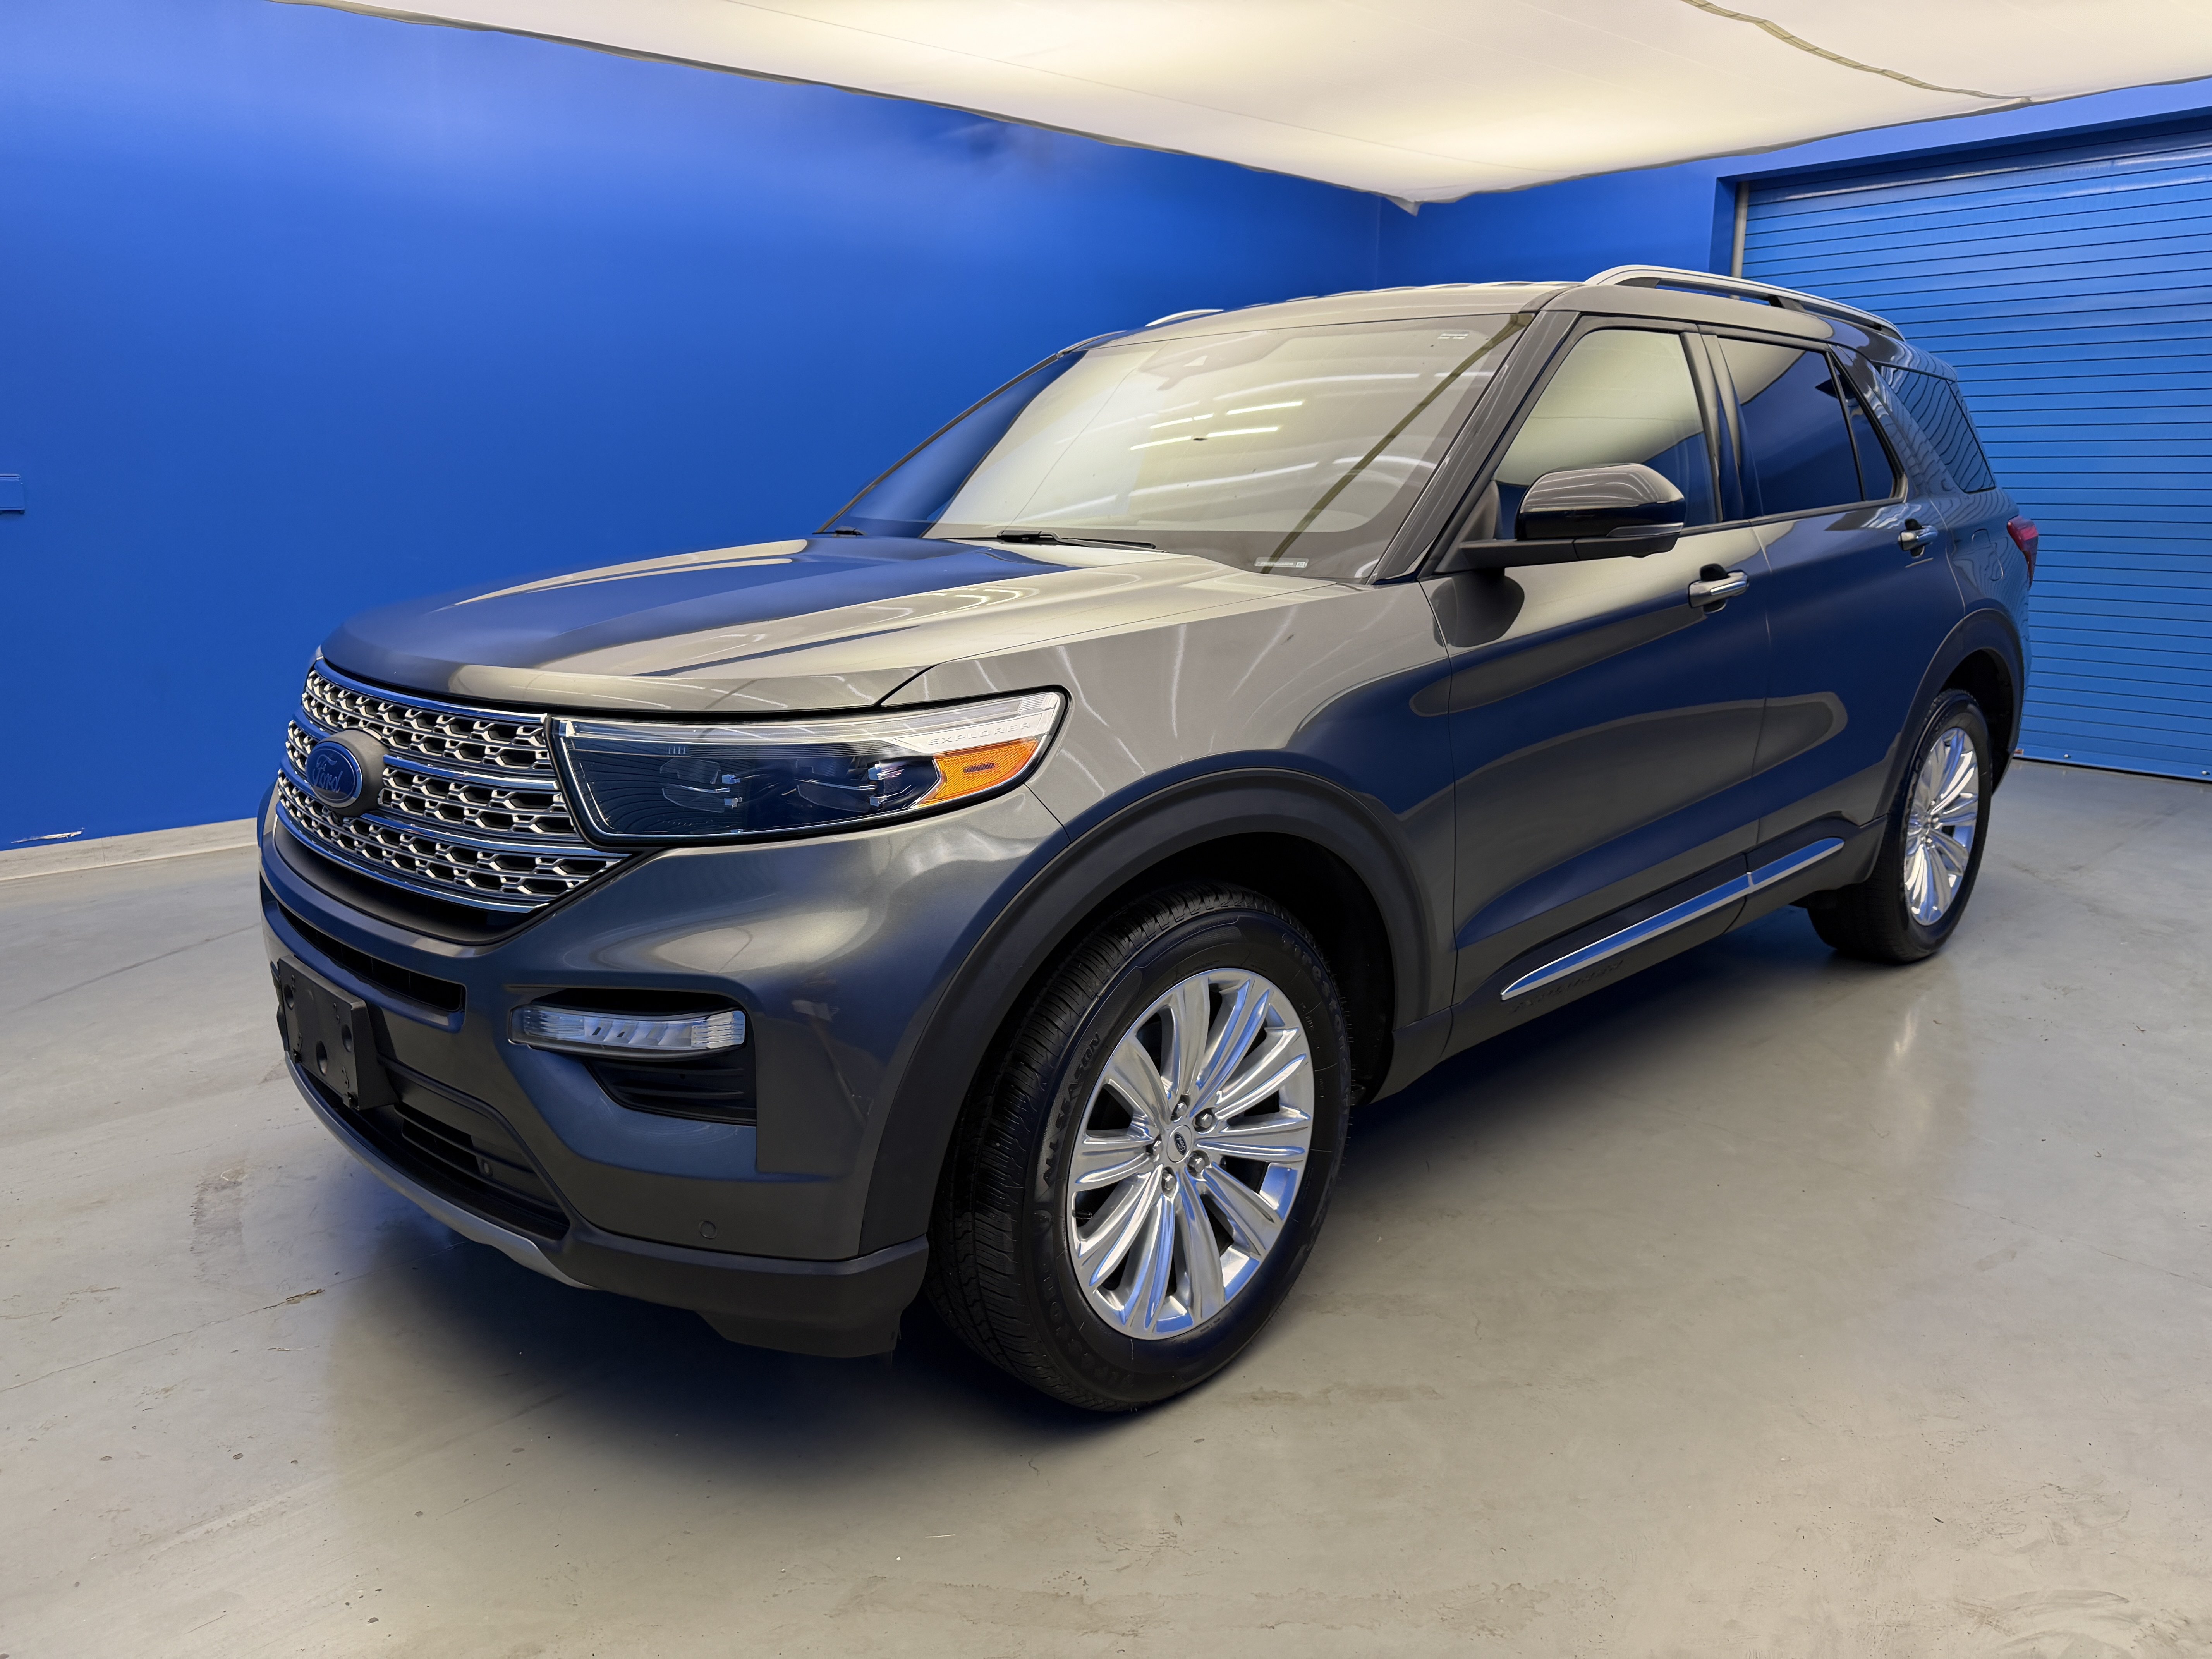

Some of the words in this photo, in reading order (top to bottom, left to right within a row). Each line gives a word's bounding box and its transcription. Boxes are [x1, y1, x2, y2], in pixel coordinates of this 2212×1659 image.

[928, 723, 1030, 746] EXPLORER
[312, 754, 343, 793] Ford
[1055, 1031, 1101, 1130] SEASON
[1176, 1136, 1186, 1151] Ford
